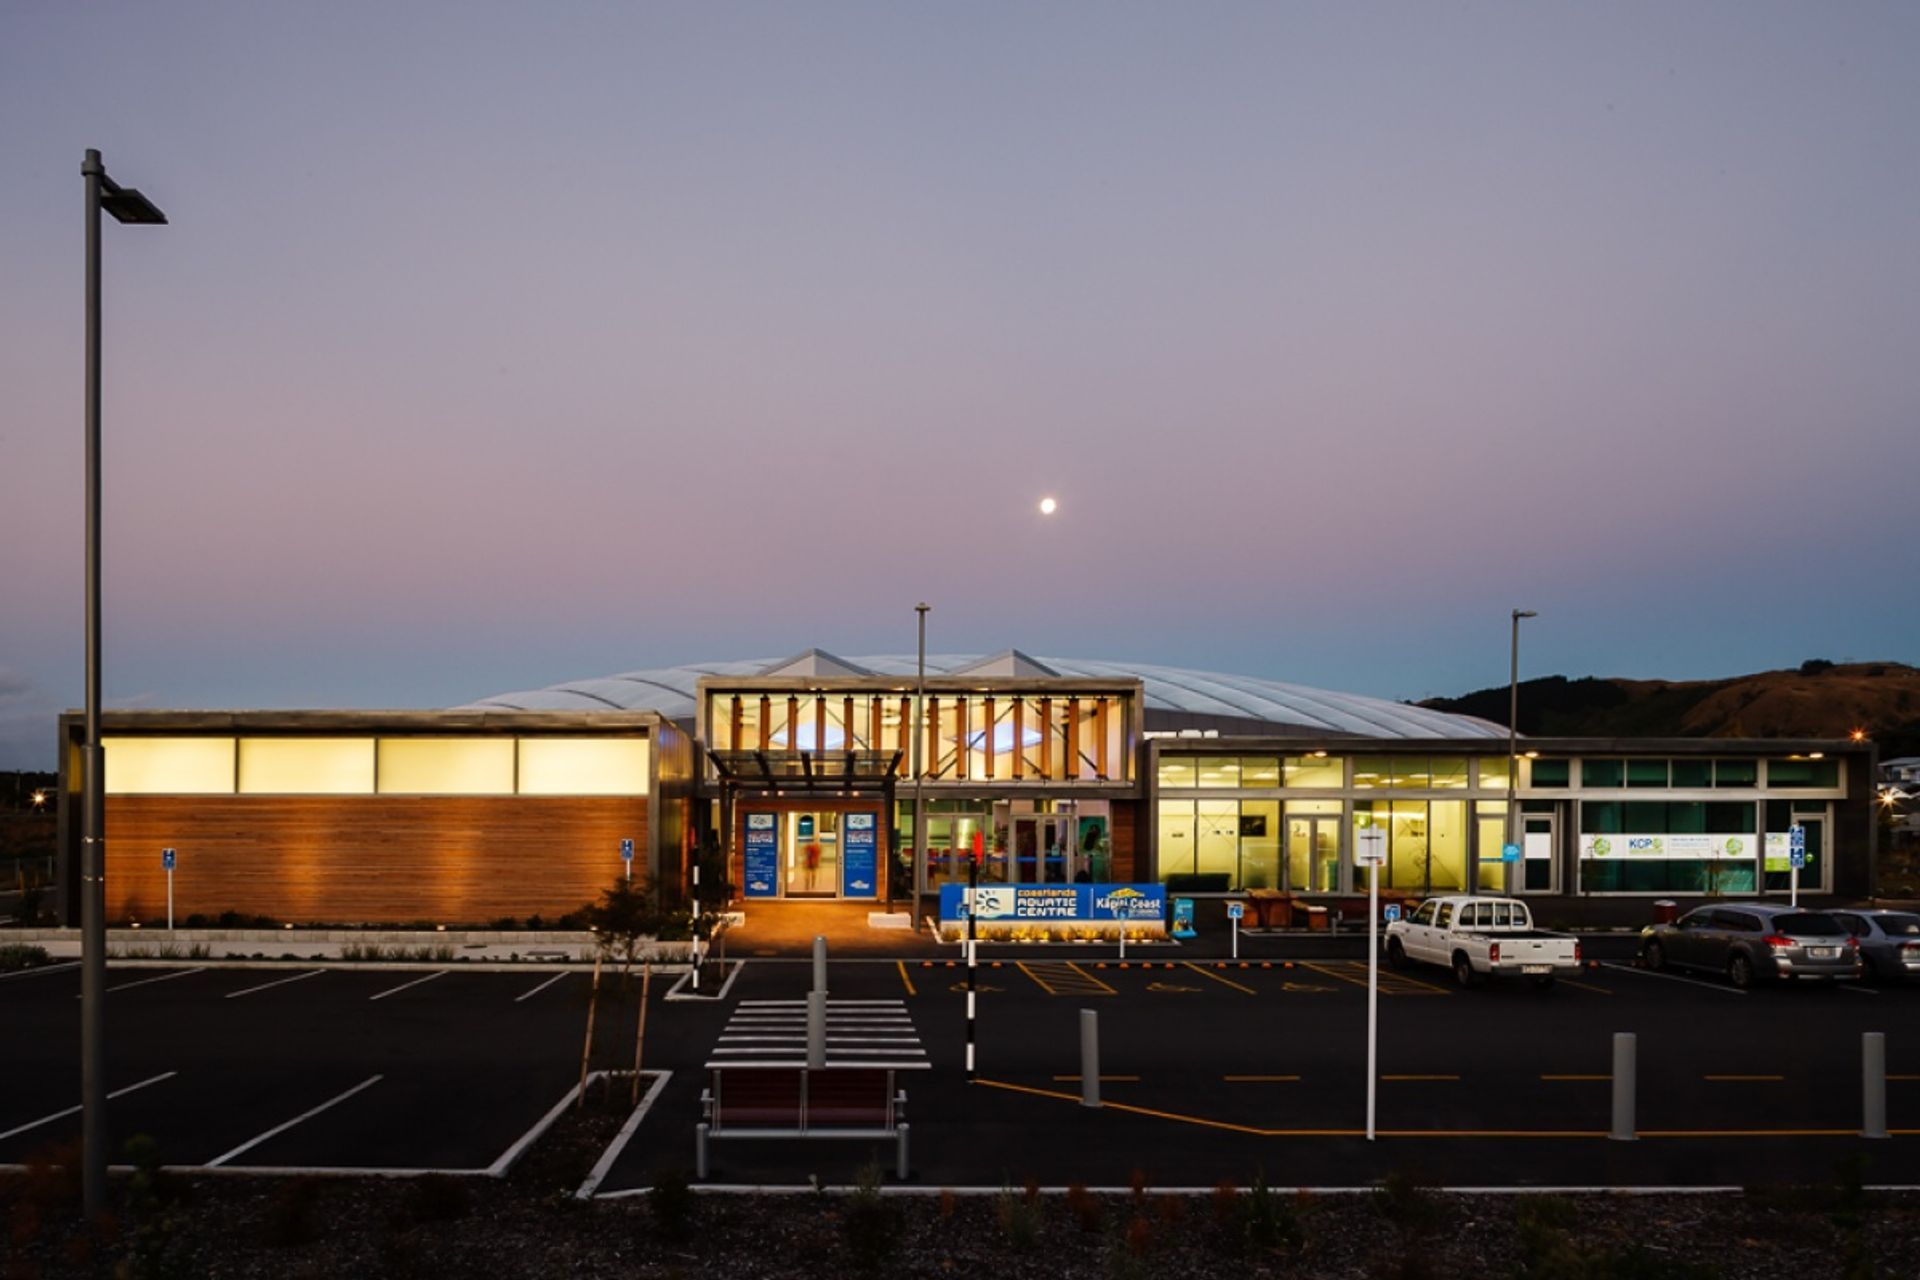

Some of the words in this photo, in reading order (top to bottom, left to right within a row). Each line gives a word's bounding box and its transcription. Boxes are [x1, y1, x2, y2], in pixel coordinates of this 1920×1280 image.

[1629, 838, 1652, 848] KCP
[1018, 888, 1077, 896] coastlands
[1018, 898, 1077, 906] AQUATIC
[1130, 897, 1161, 908] Coast
[1018, 908, 1077, 916] CENTRE
